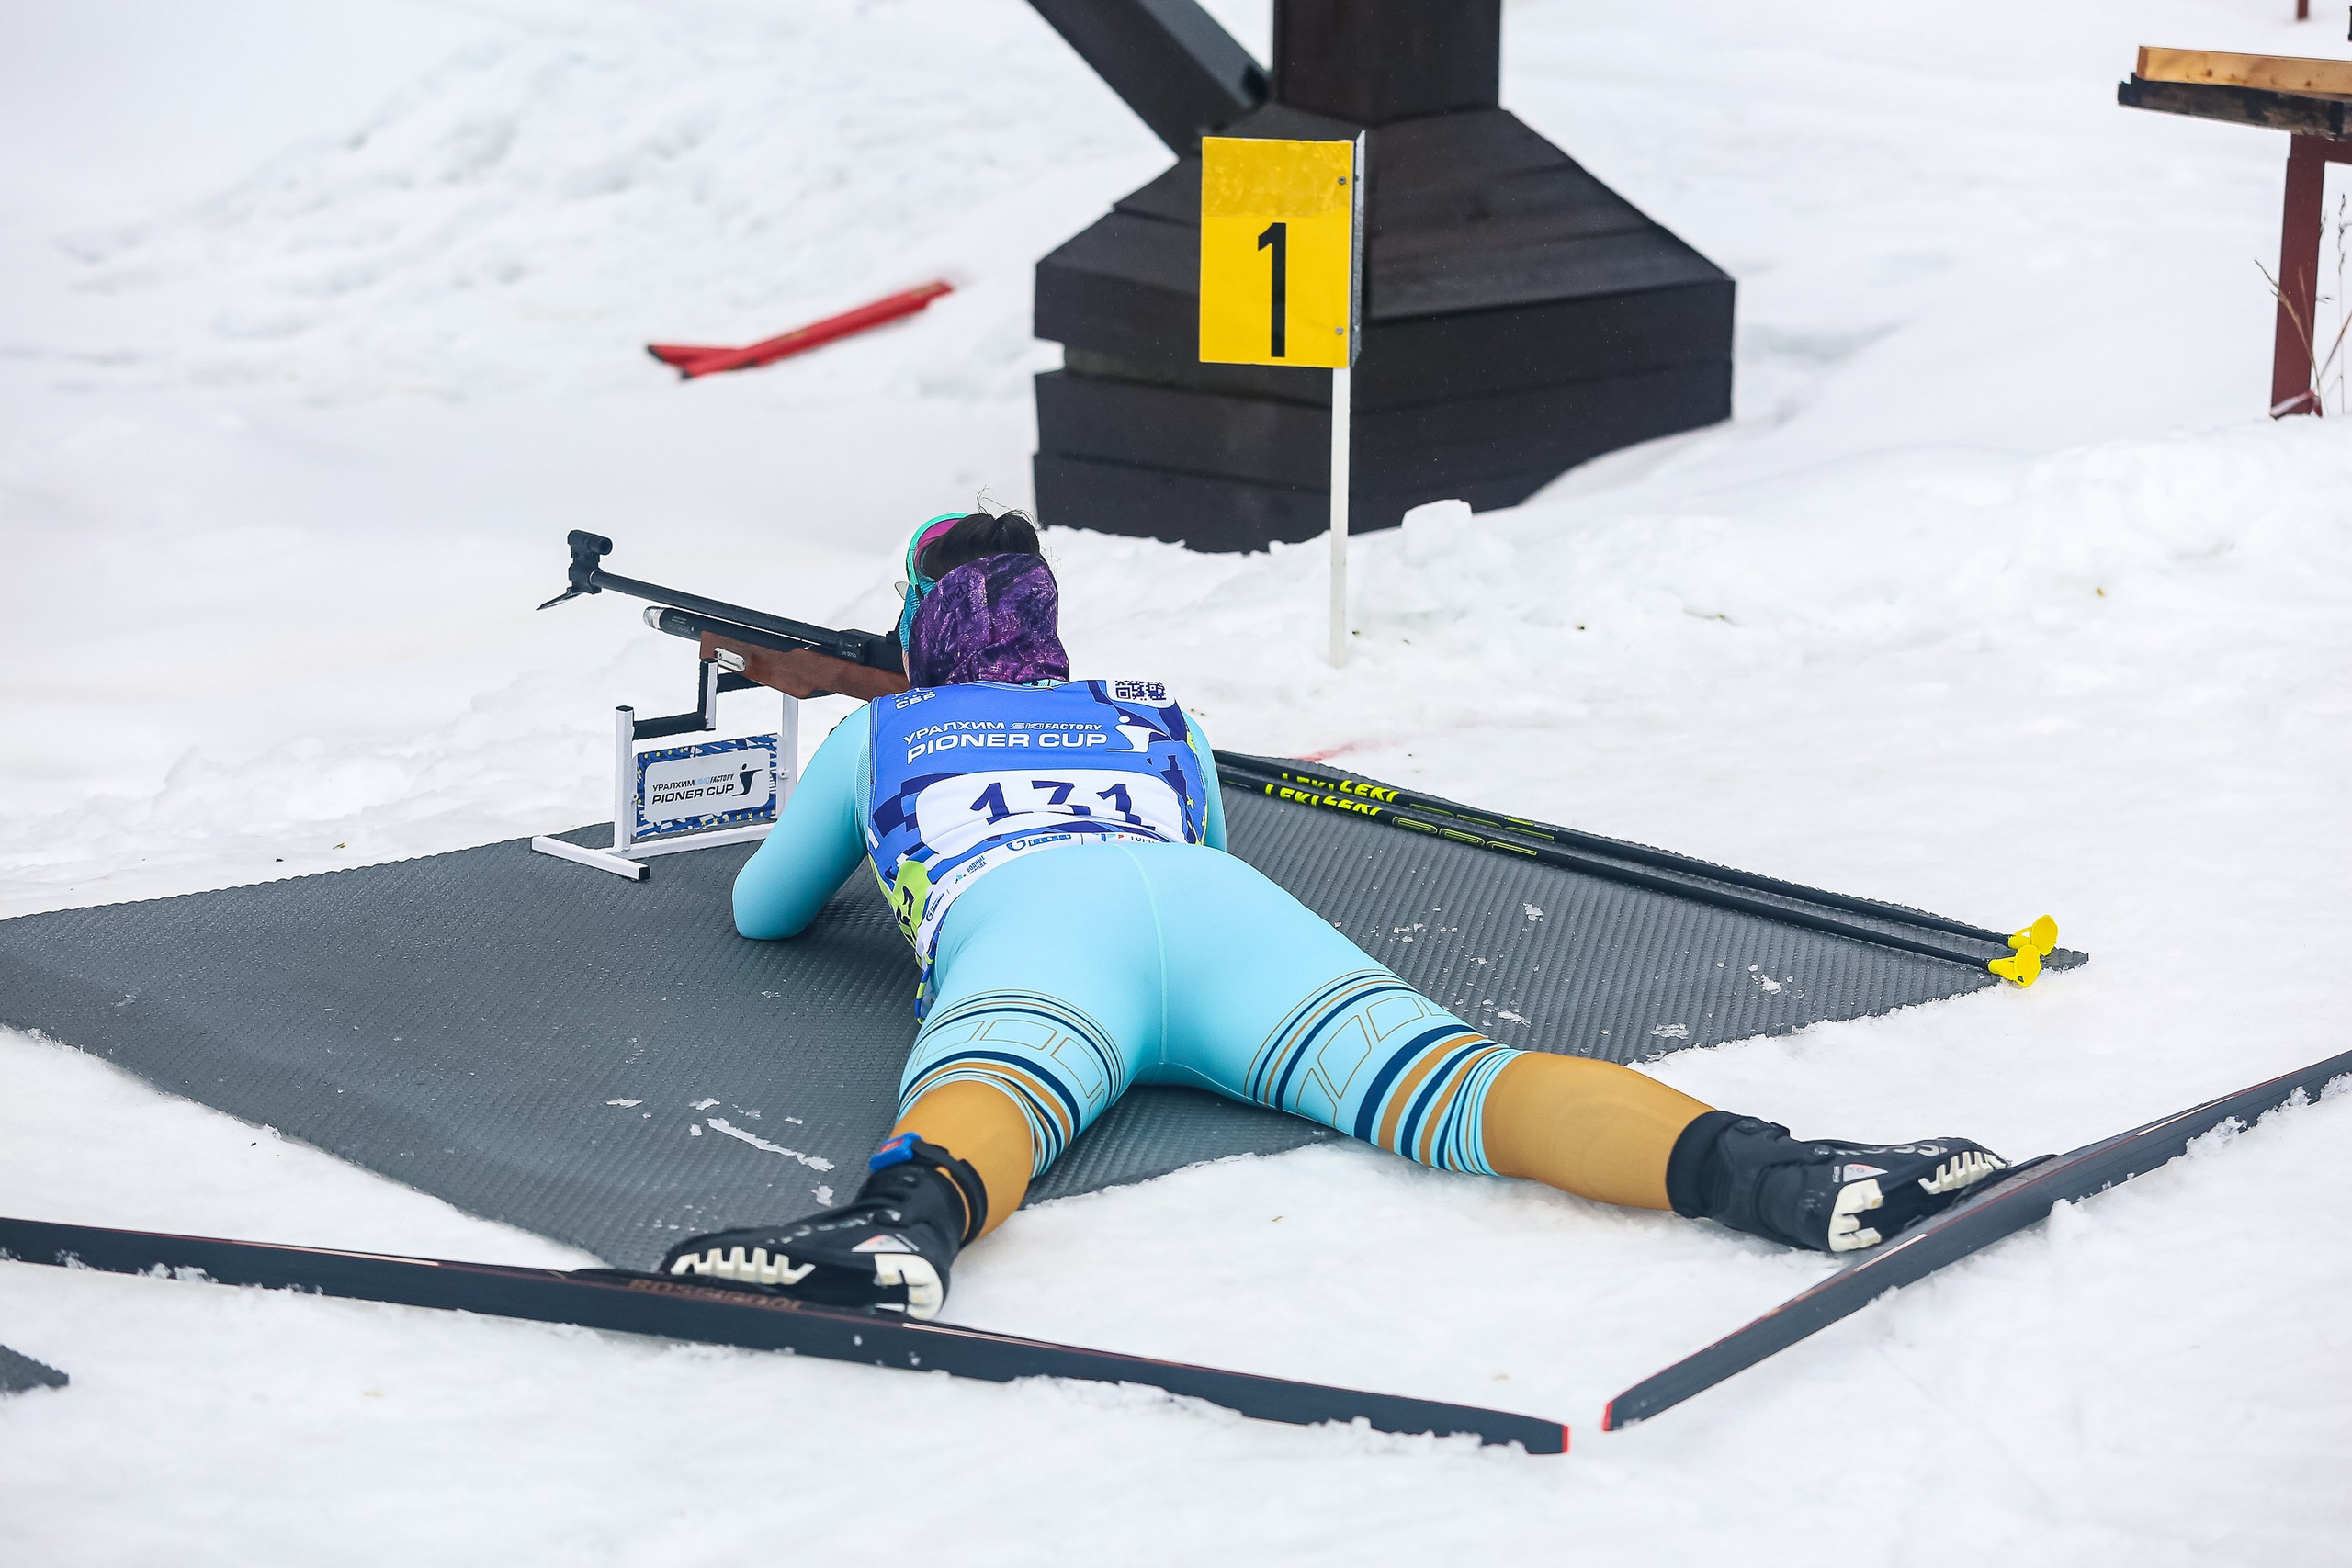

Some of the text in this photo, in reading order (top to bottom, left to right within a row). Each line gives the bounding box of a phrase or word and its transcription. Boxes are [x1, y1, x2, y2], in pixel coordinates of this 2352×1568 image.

[1258, 222, 1286, 358] 1
[902, 721, 1006, 746] УРАЛХИМ
[907, 733, 1108, 765] PIONER CUP
[651, 784, 735, 805] PIONER CUP
[652, 779, 695, 792] УРАЛХИМ
[1340, 779, 1399, 803] LEKI
